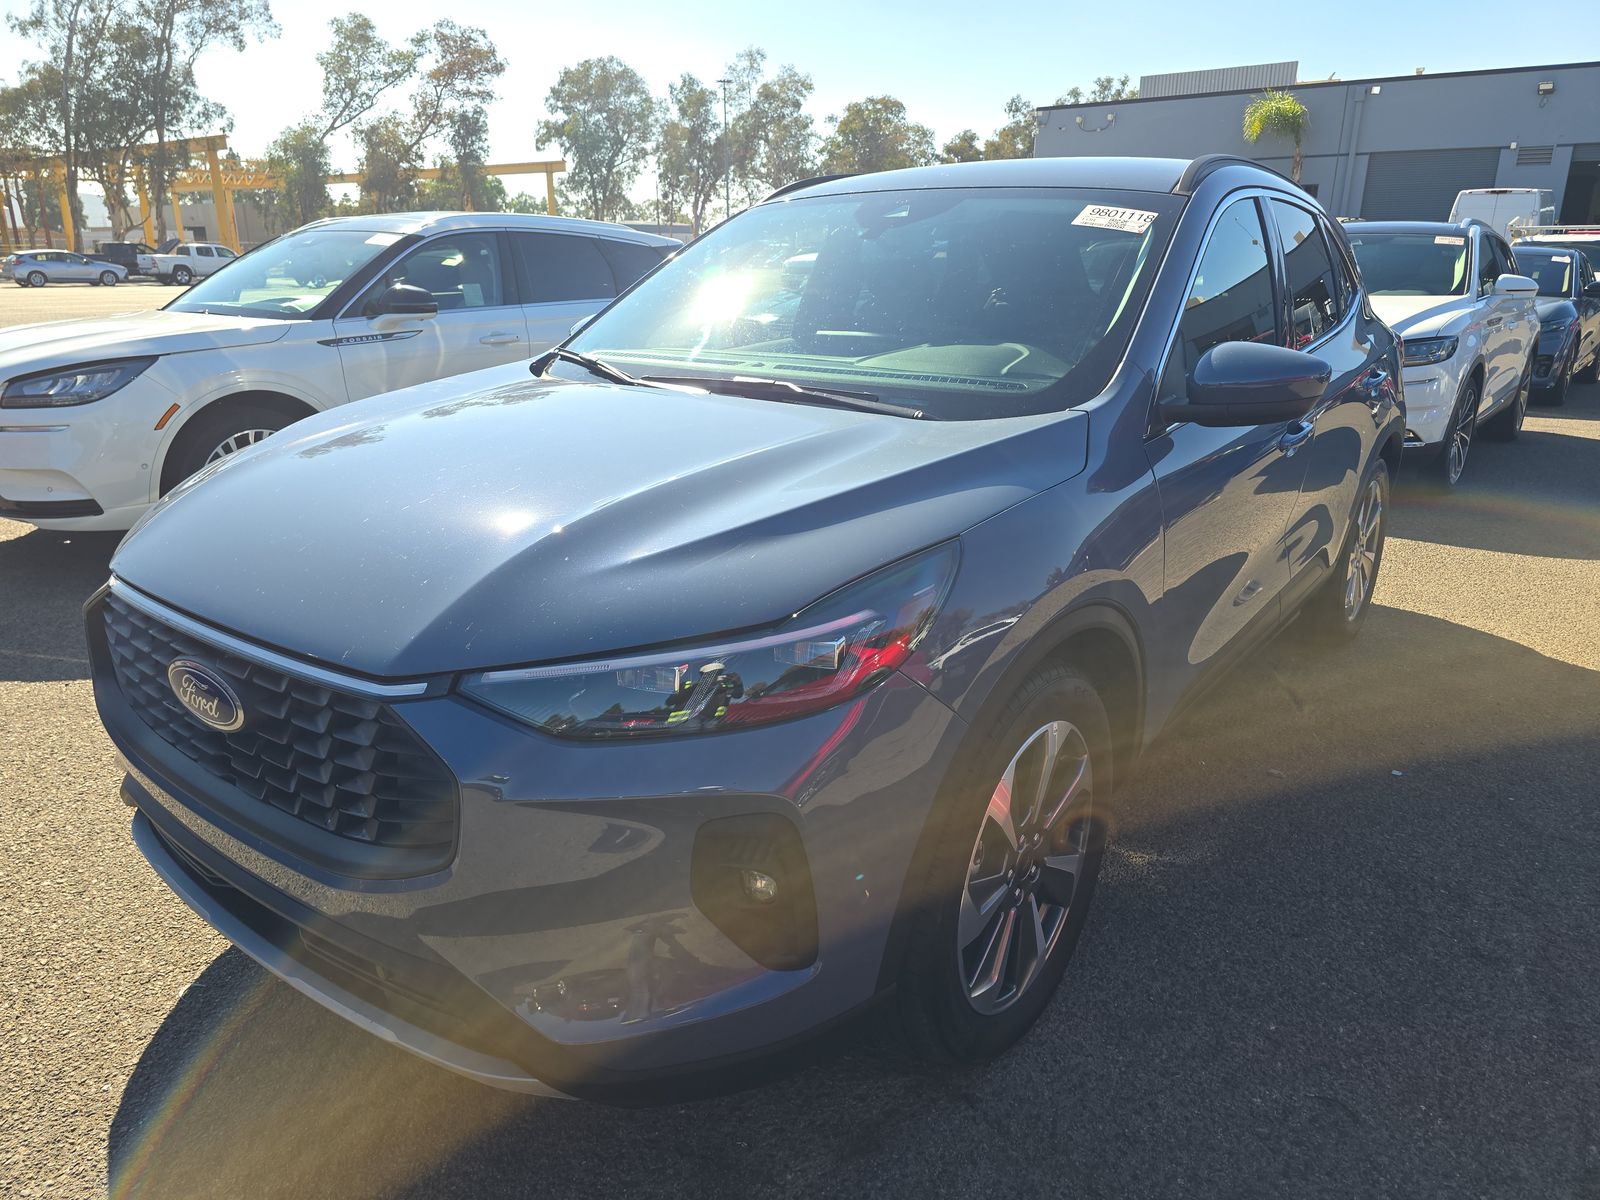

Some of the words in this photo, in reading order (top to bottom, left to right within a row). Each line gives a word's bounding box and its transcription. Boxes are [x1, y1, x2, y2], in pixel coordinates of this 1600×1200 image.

[1089, 207, 1156, 223] 9801118
[342, 335, 383, 344] CORSAIR
[180, 674, 221, 718] Ford
